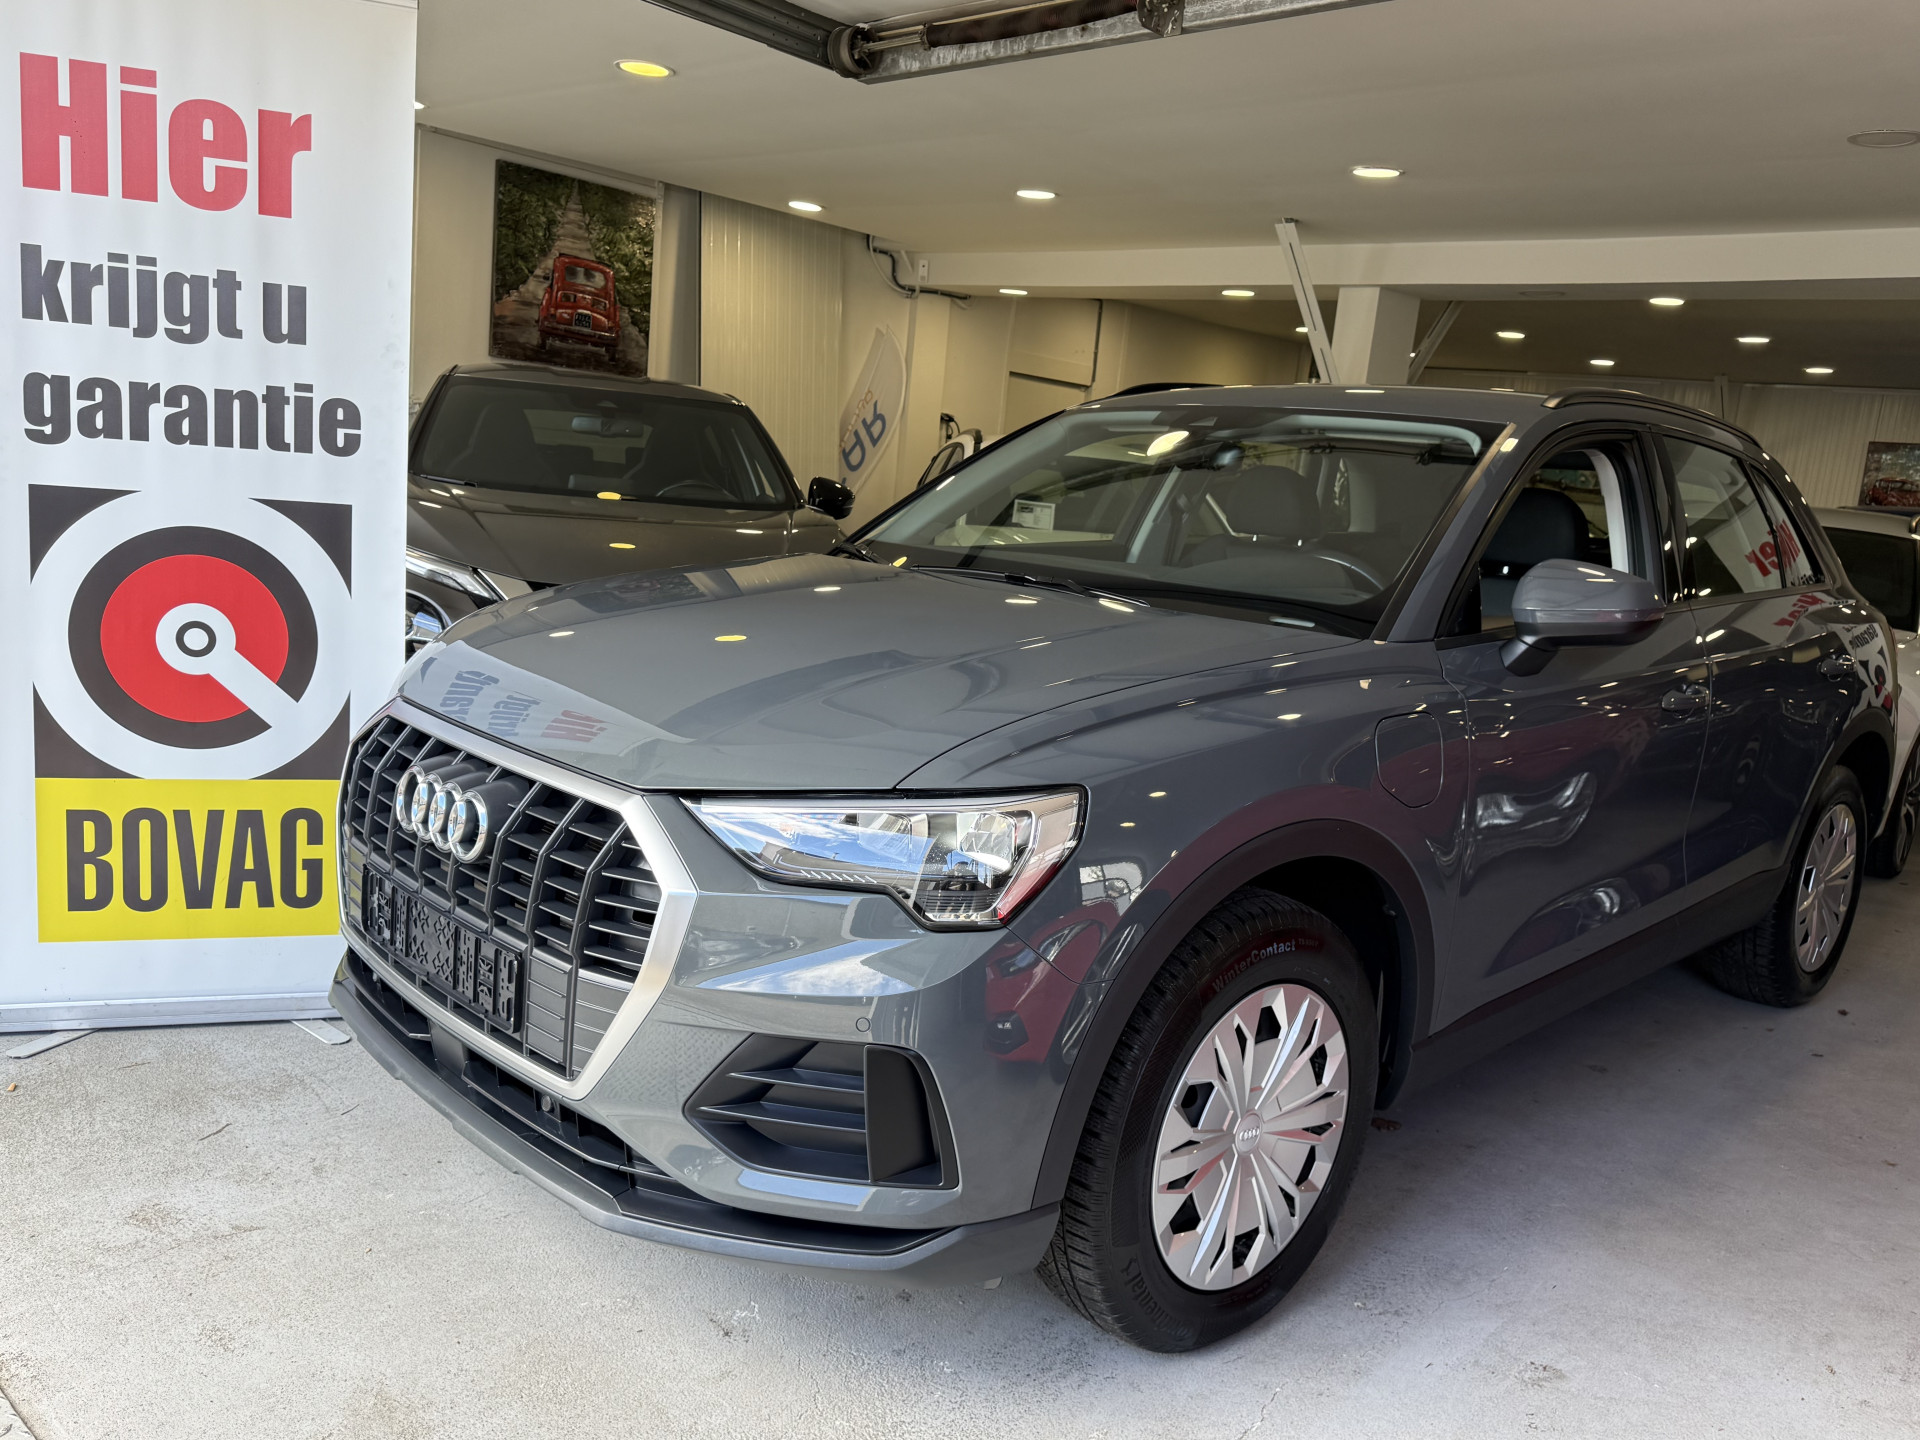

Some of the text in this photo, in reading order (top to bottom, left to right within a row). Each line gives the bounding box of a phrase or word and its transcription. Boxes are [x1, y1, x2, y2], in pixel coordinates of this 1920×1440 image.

[19, 52, 312, 219] Hier
[20, 243, 307, 346] krijgt u
[22, 371, 362, 458] garantie
[66, 807, 323, 912] BOVAG
[1211, 938, 1297, 993] WinterContact
